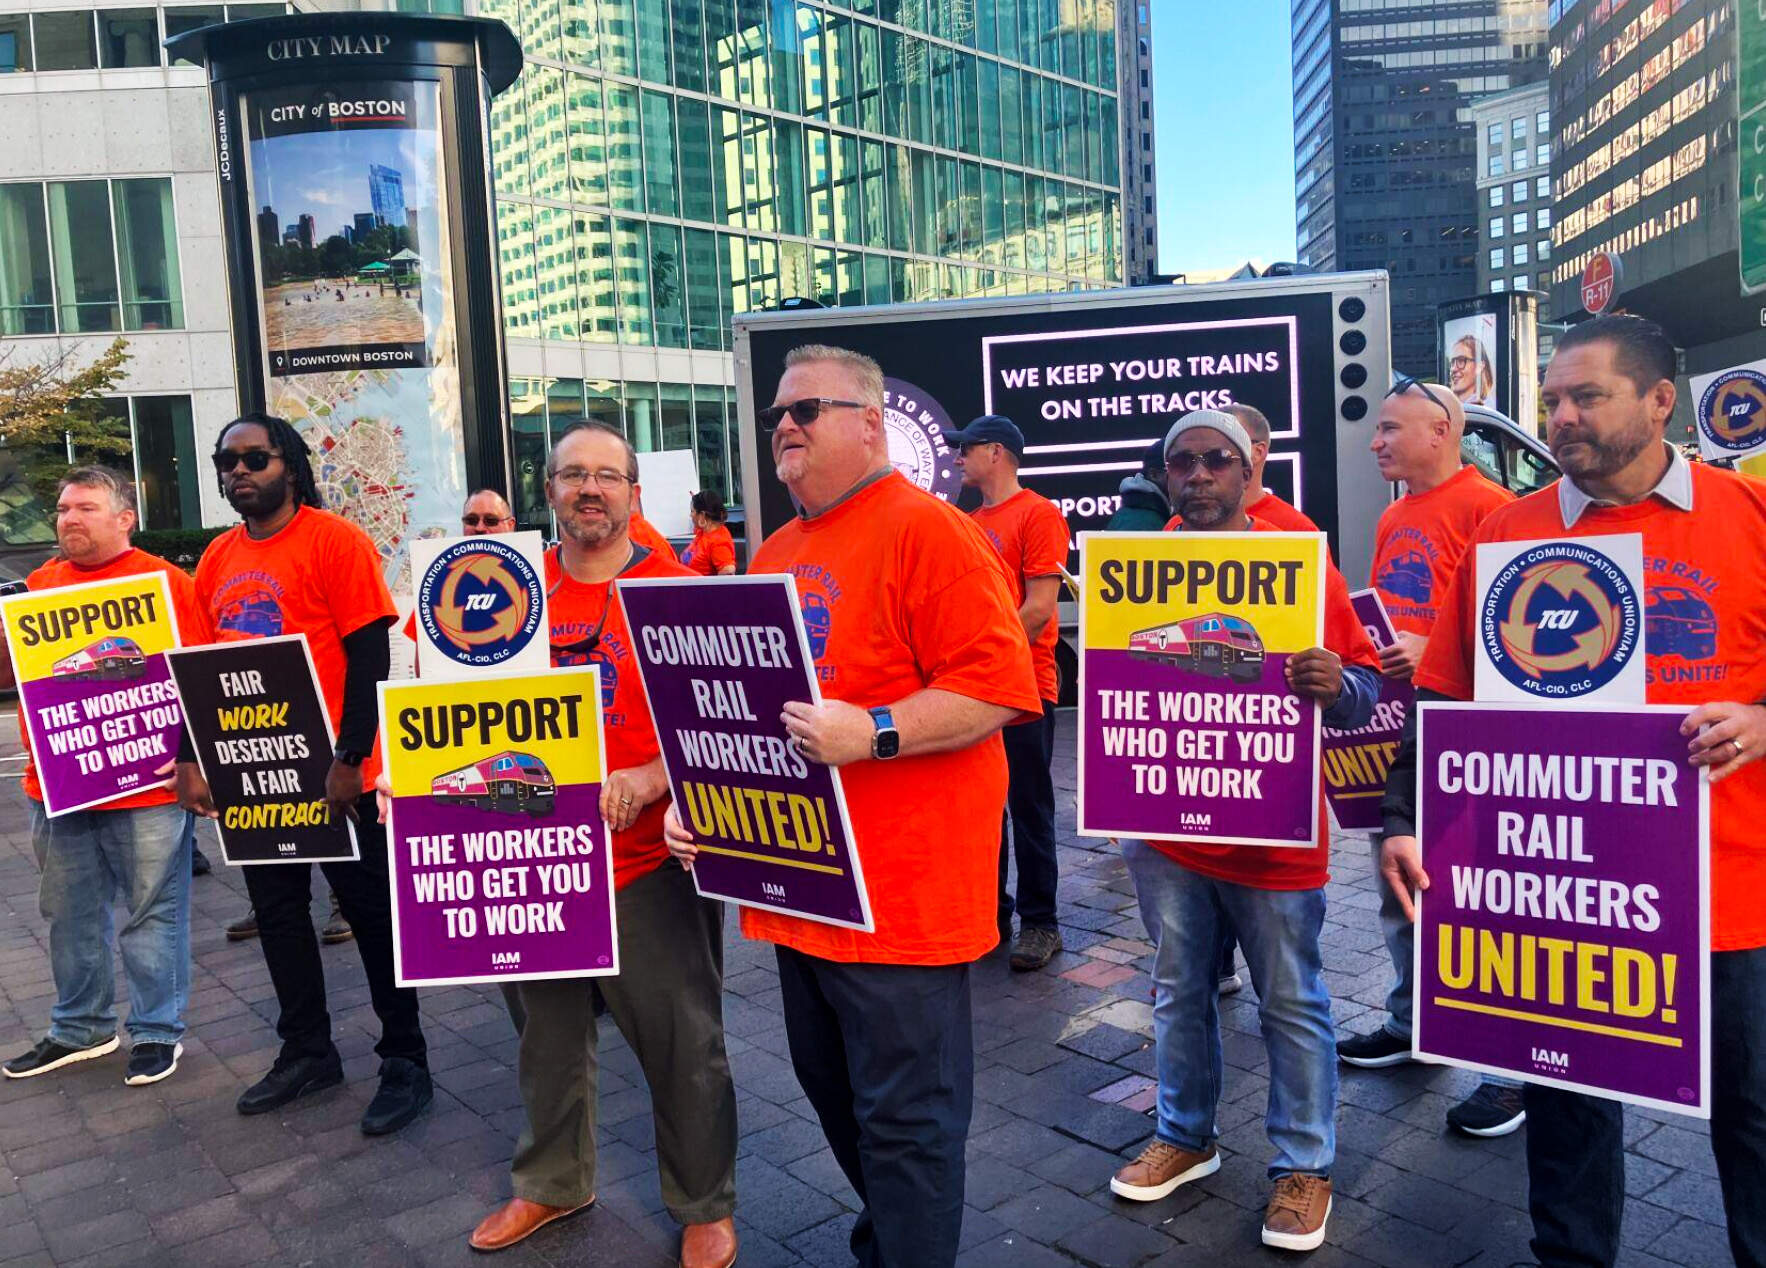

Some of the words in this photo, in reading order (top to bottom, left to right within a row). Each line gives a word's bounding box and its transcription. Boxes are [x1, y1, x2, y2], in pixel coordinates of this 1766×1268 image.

[267, 36, 323, 61] CITY
[330, 34, 391, 55] MAP
[271, 105, 305, 122] CITY
[312, 103, 324, 118] of
[328, 100, 406, 117] BOSTON
[217, 108, 230, 181] JCDecaux
[1592, 259, 1602, 281] F
[1586, 282, 1609, 305] R-11
[292, 353, 360, 367] DOWNTOWN
[363, 351, 413, 362] BOSTON
[1000, 367, 1039, 389] WE
[1046, 363, 1103, 386] KEEP
[1109, 358, 1182, 382] YOUR
[1187, 351, 1280, 376] TRAINS
[1041, 400, 1082, 421] ON
[1088, 396, 1133, 417] THE
[1137, 388, 1240, 414] TRACKS.
[1729, 402, 1750, 417] TCU
[898, 394, 917, 413] TO
[918, 410, 950, 457] WORK
[453, 542, 533, 580] COMMUNICATIONS
[524, 581, 540, 634] UNION/IAM
[1100, 560, 1304, 605] SUPPORT
[1671, 562, 1719, 594] RAIL
[421, 558, 447, 640] TRANSPORTATION
[465, 594, 496, 611] TCU
[1485, 564, 1519, 662] TRANSPORTATION
[1528, 547, 1628, 594] COMMUNICATIONS
[1613, 596, 1635, 663] UNION/IAM
[18, 592, 157, 647] SUPPORT
[1537, 610, 1579, 629] TCU
[493, 648, 510, 661] CLC
[641, 625, 793, 668] COMMUTER
[219, 669, 266, 698] FAIR
[1523, 679, 1568, 694] AFL-CIO,
[1571, 679, 1592, 692] CLC
[1661, 664, 1728, 683] UNITE!
[38, 701, 80, 731] THE
[81, 679, 177, 720] WORKERS
[217, 701, 290, 732] WORK
[691, 679, 758, 721] RAIL
[1098, 690, 1150, 720] THE
[1158, 691, 1301, 726] WORKERS
[47, 725, 98, 756] WHO
[101, 714, 137, 742] GET
[139, 704, 181, 732] YOU
[399, 694, 582, 751] SUPPORT
[75, 750, 104, 776] TO
[106, 733, 168, 768] WORK
[214, 734, 310, 765] DESERVES
[676, 729, 808, 779] WORKERS
[1102, 727, 1167, 758] WHO
[1176, 729, 1228, 760] GET
[1236, 731, 1295, 763] YOU
[117, 773, 139, 787] IAM
[241, 772, 256, 796] A
[256, 768, 302, 796] FAIR
[1132, 764, 1167, 795] TO
[1176, 766, 1263, 799] WORK
[1438, 751, 1678, 807] COMMUTER
[682, 781, 836, 856] UNITED!
[1181, 812, 1211, 826] IAM
[278, 842, 296, 852] IAM
[406, 834, 456, 867] THE
[462, 824, 594, 863] WORKERS
[1498, 811, 1594, 863] RAIL
[413, 870, 474, 903] WHO
[482, 866, 529, 899] GET
[536, 862, 591, 895] YOU
[762, 882, 785, 897] IAM
[1451, 865, 1661, 932] WORKERS
[443, 907, 477, 938] TO
[484, 901, 566, 936] WORK
[492, 952, 520, 965] IAM
[1438, 924, 1677, 1024] UNITED!
[1531, 1047, 1569, 1068] IAM
